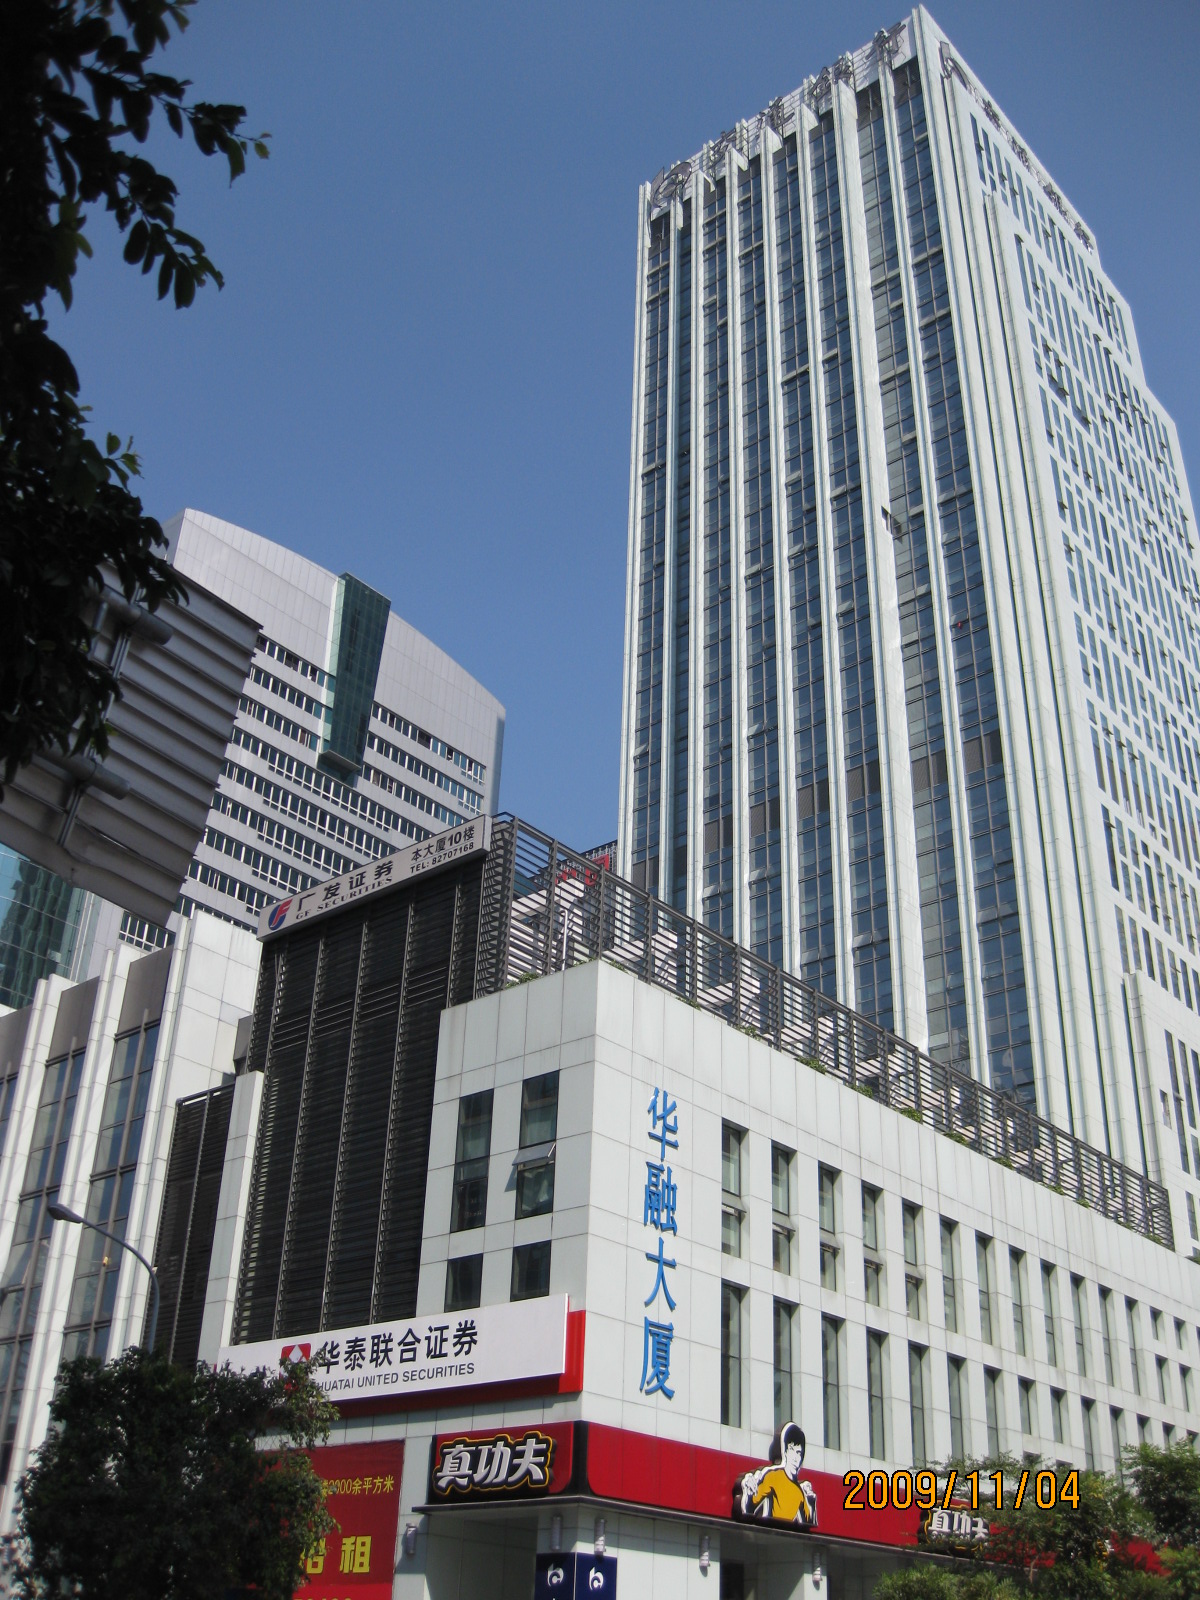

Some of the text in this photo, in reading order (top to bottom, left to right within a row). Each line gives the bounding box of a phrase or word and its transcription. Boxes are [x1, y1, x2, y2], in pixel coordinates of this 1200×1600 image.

[410, 841, 474, 874] TEL: 82707168
[411, 825, 474, 862] 本大厦10楼
[296, 876, 393, 920] GF SECURITIES
[297, 861, 394, 912] 广发证券
[640, 1086, 680, 1401] 华融大厦
[319, 1319, 478, 1374] 华泰联合证券
[316, 1362, 476, 1392] HUATAI UNITED SECURITIES
[435, 1438, 547, 1488] 真功夫
